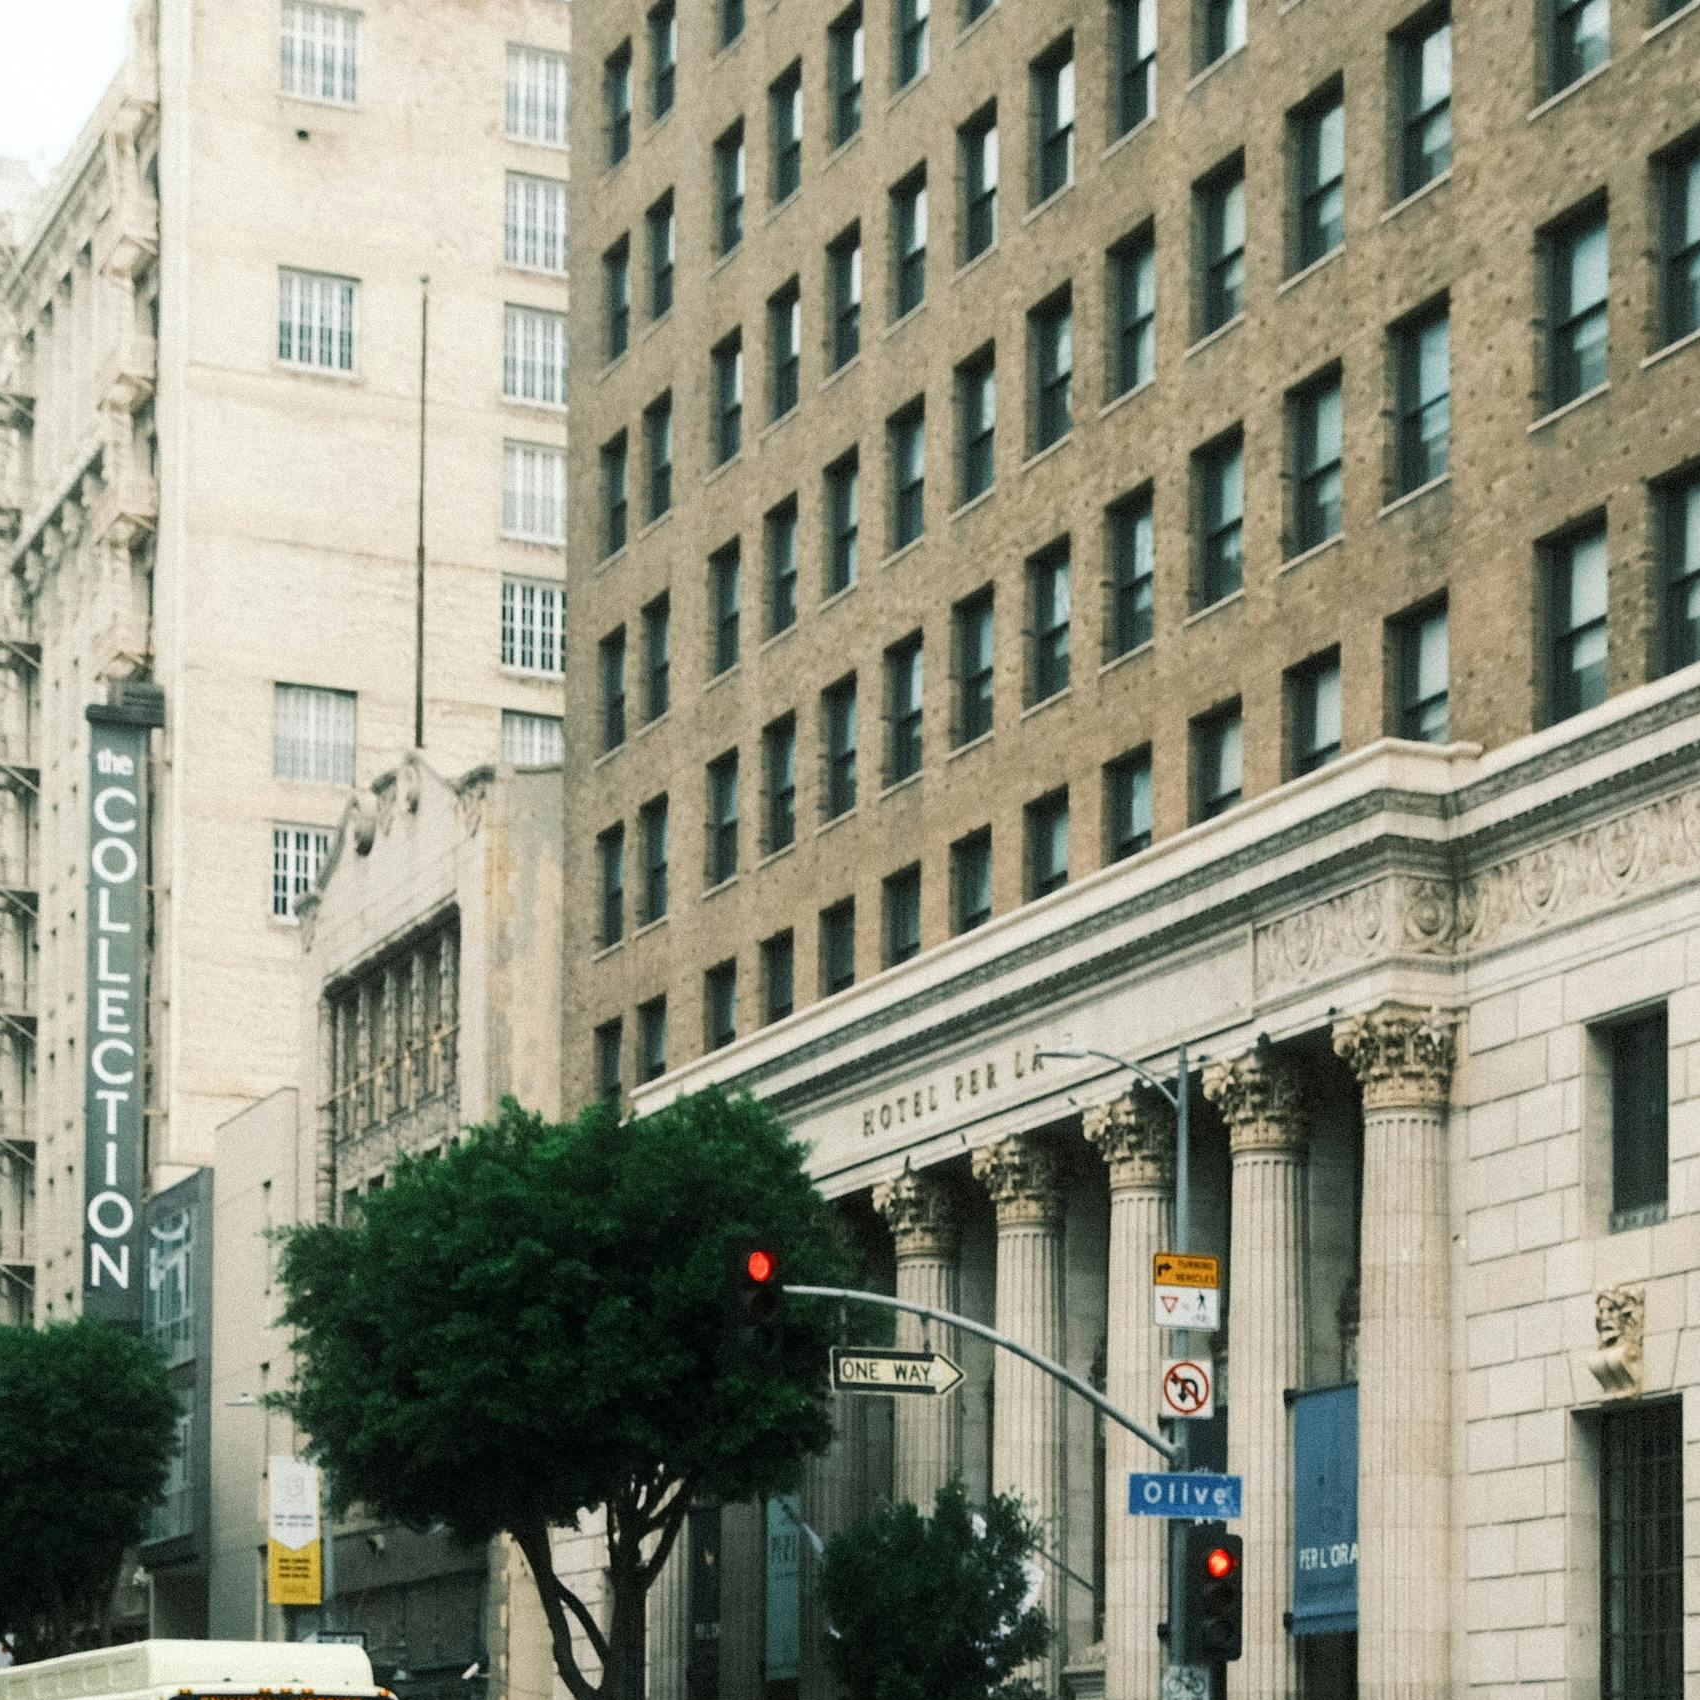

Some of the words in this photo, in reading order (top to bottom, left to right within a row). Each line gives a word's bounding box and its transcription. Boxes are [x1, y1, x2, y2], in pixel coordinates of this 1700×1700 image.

[97, 749, 134, 776] the
[87, 787, 138, 1290] COLLECTION
[863, 1085, 938, 1137] HOTEL
[954, 1062, 997, 1101] PER
[1015, 1044, 1045, 1079] LA
[842, 1360, 880, 1380] ONE
[893, 1362, 931, 1382] WAY
[1143, 1481, 1229, 1505] Olive
[1299, 1547, 1318, 1570] PER
